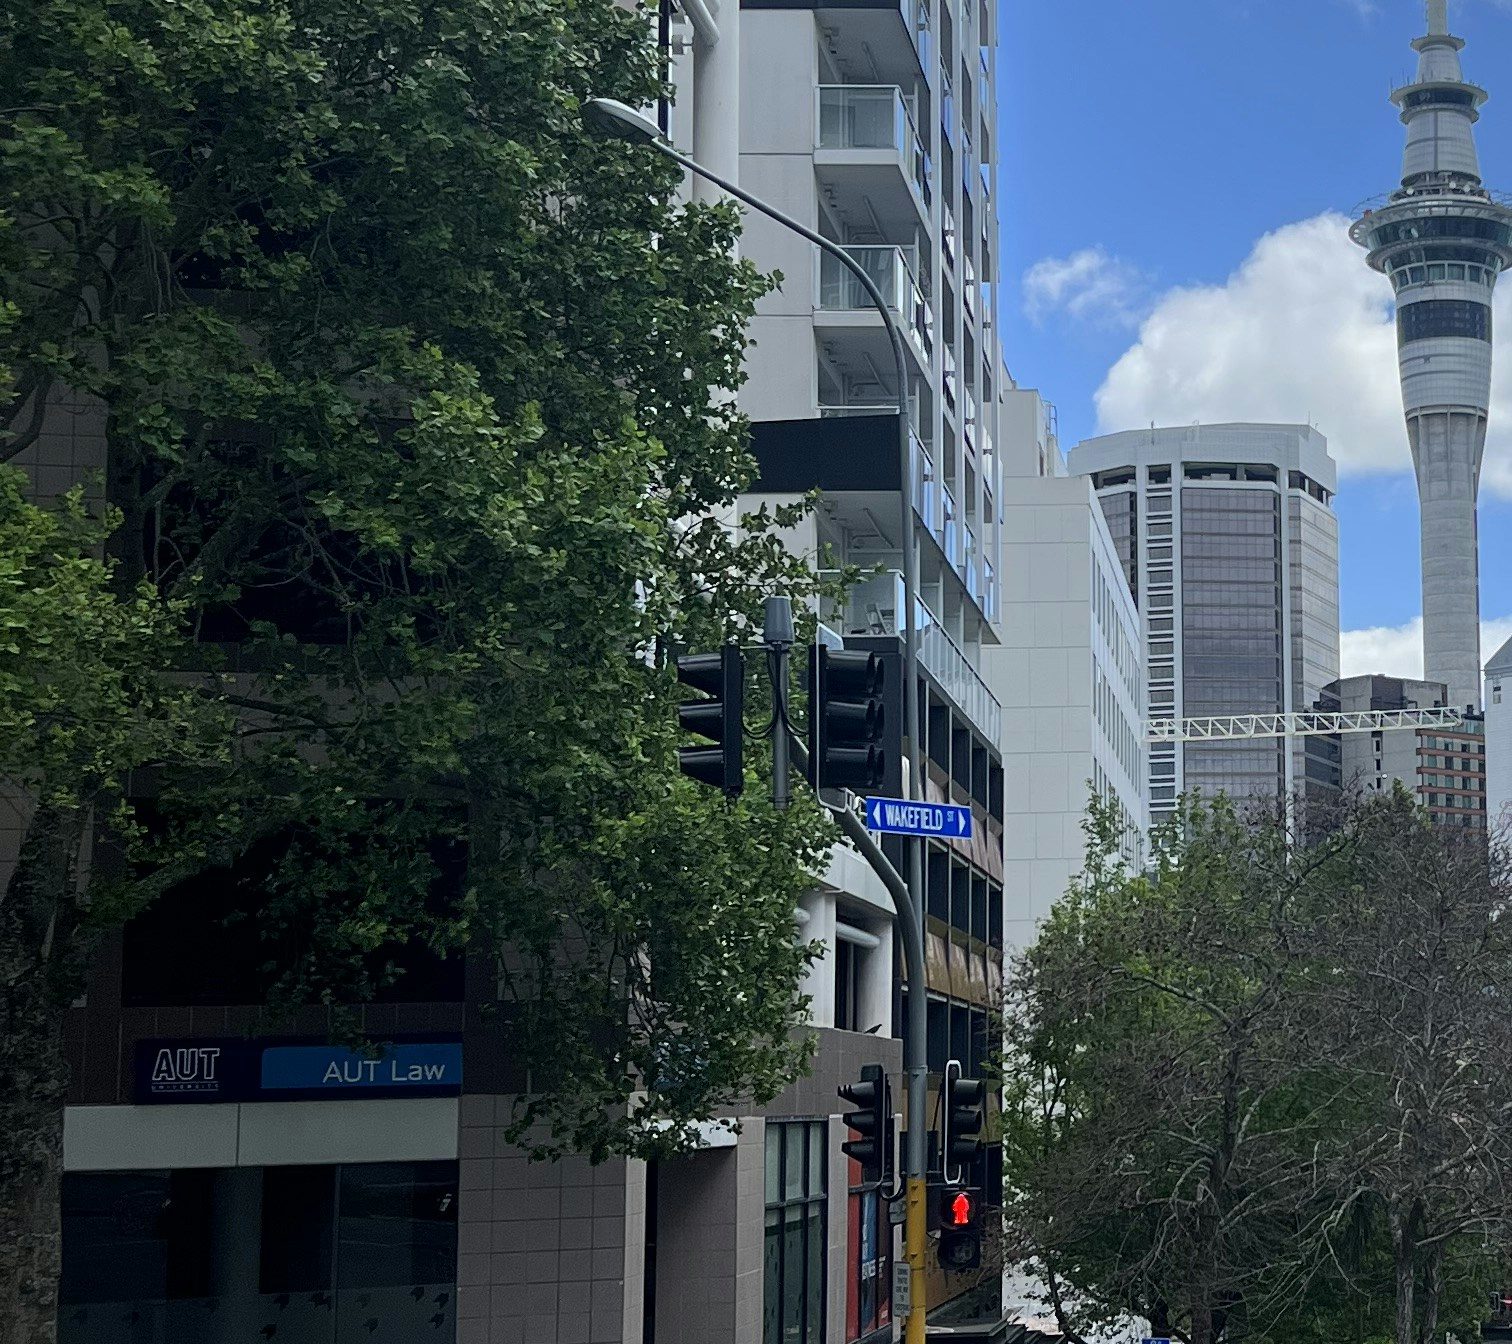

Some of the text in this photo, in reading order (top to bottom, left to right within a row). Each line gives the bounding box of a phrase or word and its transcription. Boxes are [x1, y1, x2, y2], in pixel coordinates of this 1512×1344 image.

[885, 804, 955, 830] WAKEFIELD ST
[152, 1048, 220, 1080] AUT
[323, 1061, 446, 1083] AUT Law
